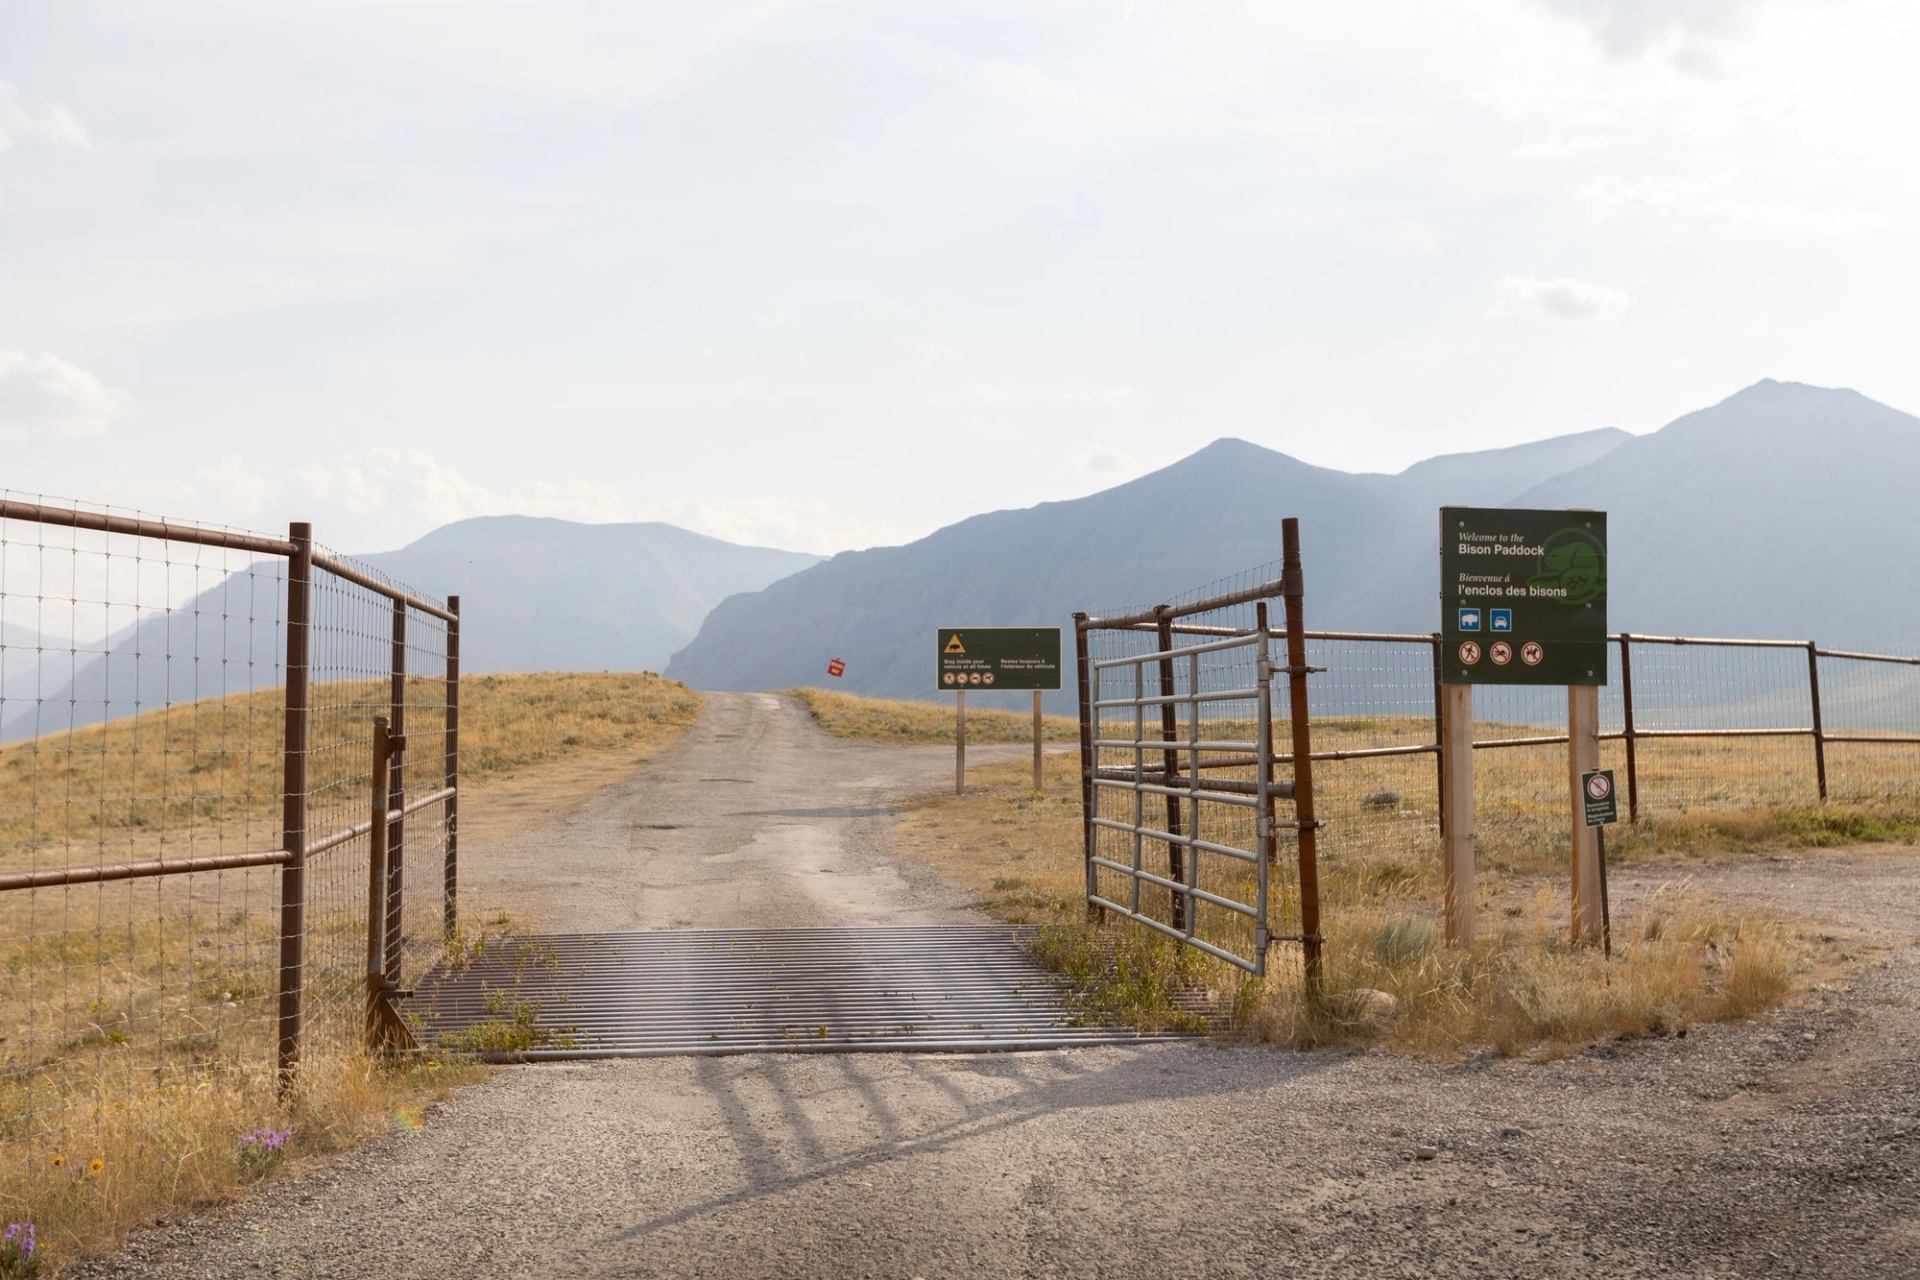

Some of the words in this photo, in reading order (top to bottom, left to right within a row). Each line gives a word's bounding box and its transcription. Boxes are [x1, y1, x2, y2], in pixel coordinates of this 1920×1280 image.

[1459, 532, 1497, 542] Welcome
[1499, 533, 1508, 542] to
[1510, 533, 1524, 542] the
[1458, 543, 1491, 554] Bison
[1494, 544, 1544, 556] Paddock
[1459, 573, 1503, 582] Bienvenue
[1458, 584, 1502, 595] l'enclos
[1506, 585, 1527, 596] des
[1529, 585, 1567, 596] bisons
